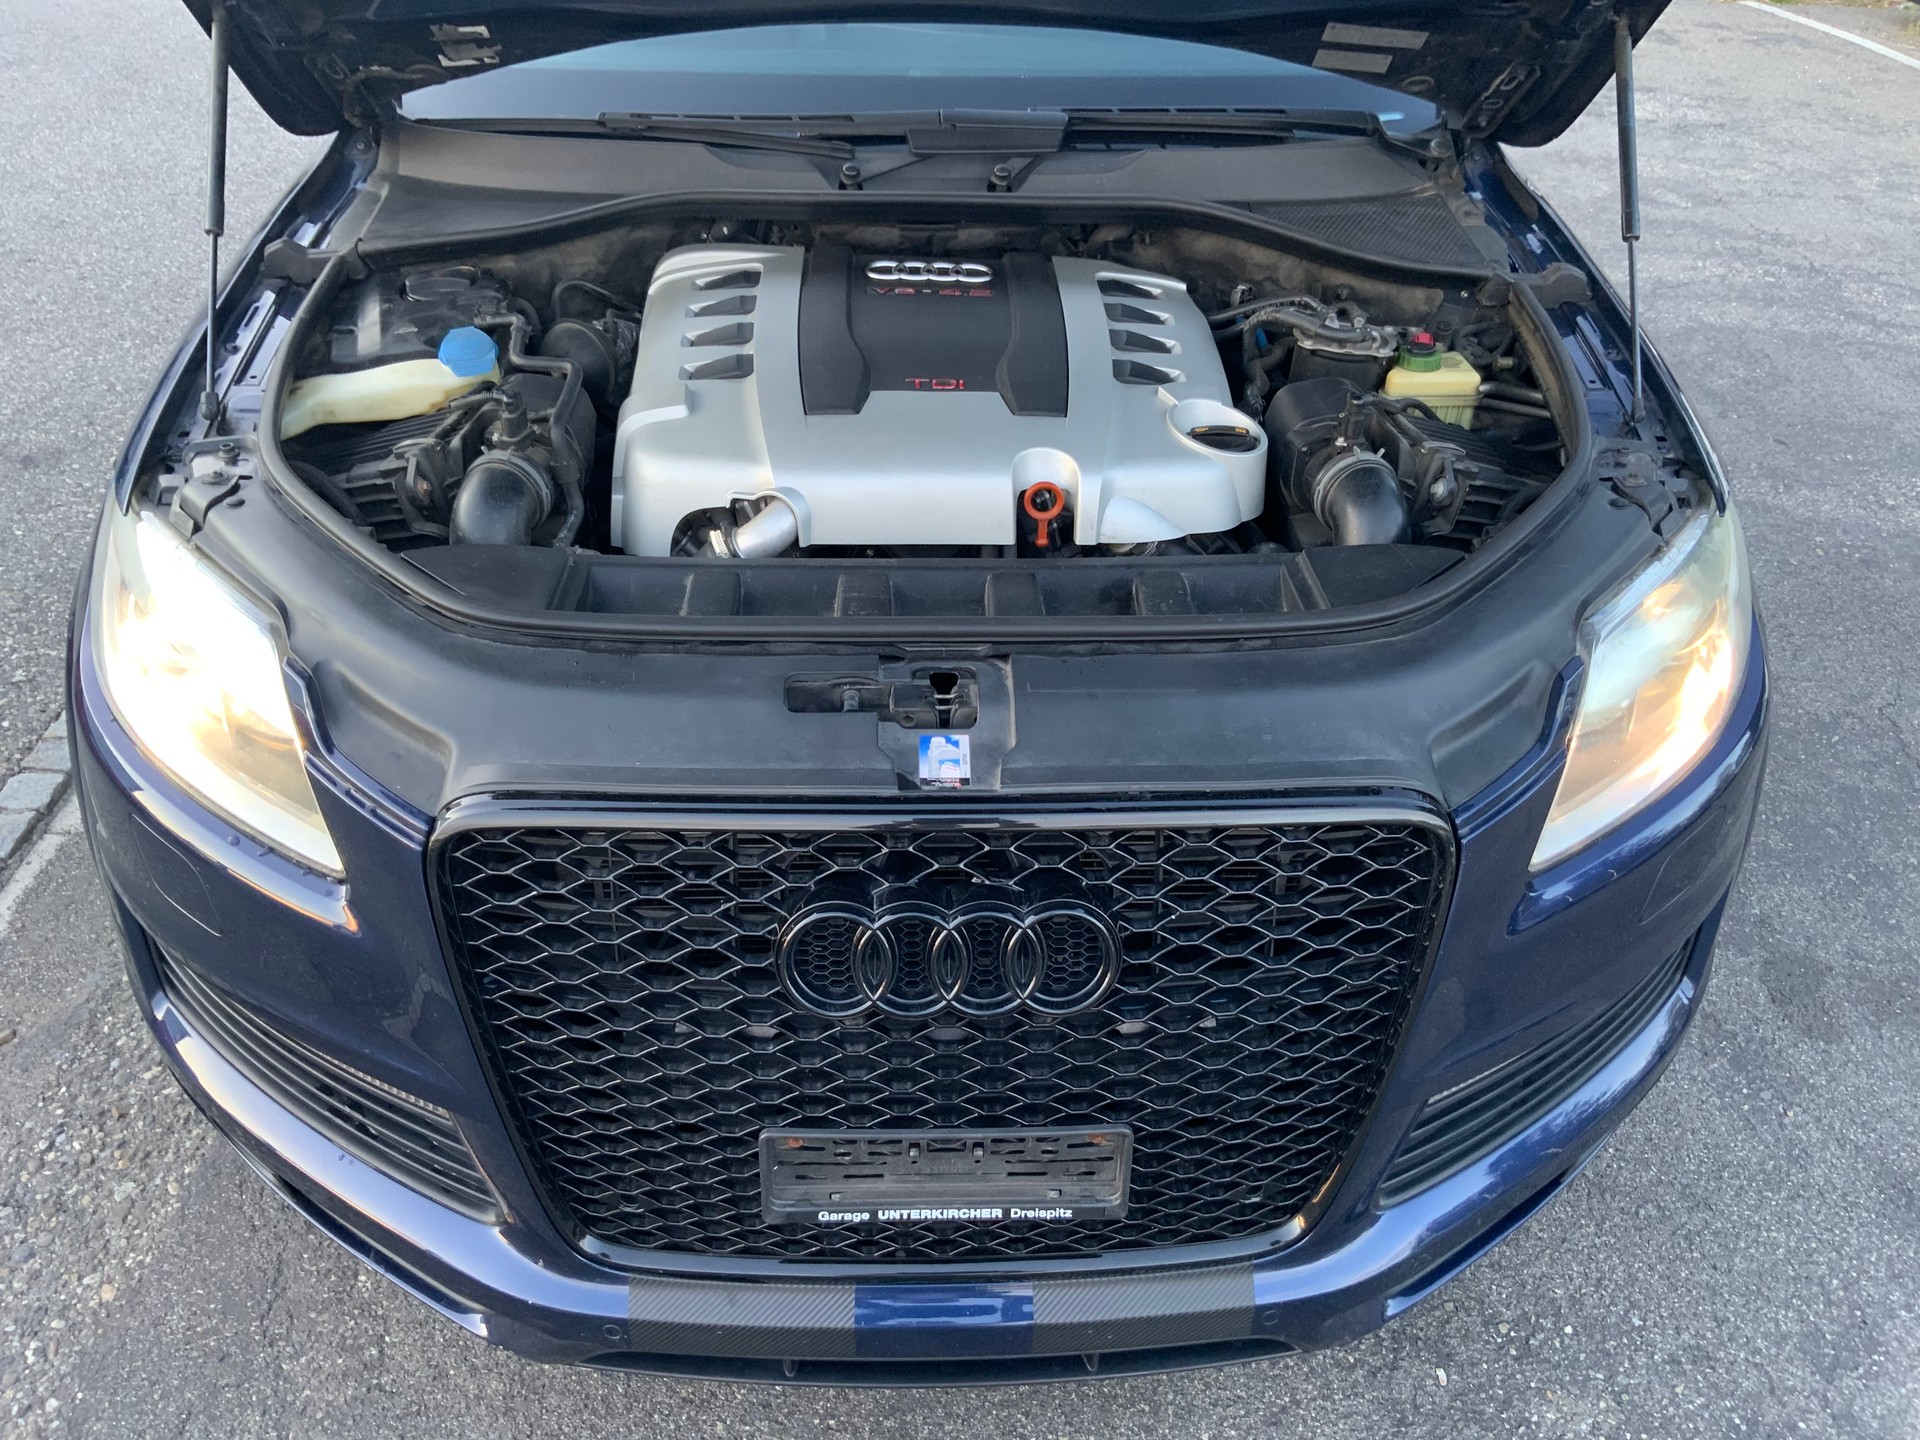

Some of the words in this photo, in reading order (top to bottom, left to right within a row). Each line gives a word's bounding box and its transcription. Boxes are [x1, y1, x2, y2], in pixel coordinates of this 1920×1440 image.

[905, 378, 965, 389] TDI
[818, 1211, 870, 1222] Garage
[878, 1208, 1003, 1220] UNTERKIRCHER
[1010, 1208, 1073, 1220] Dreispitz
